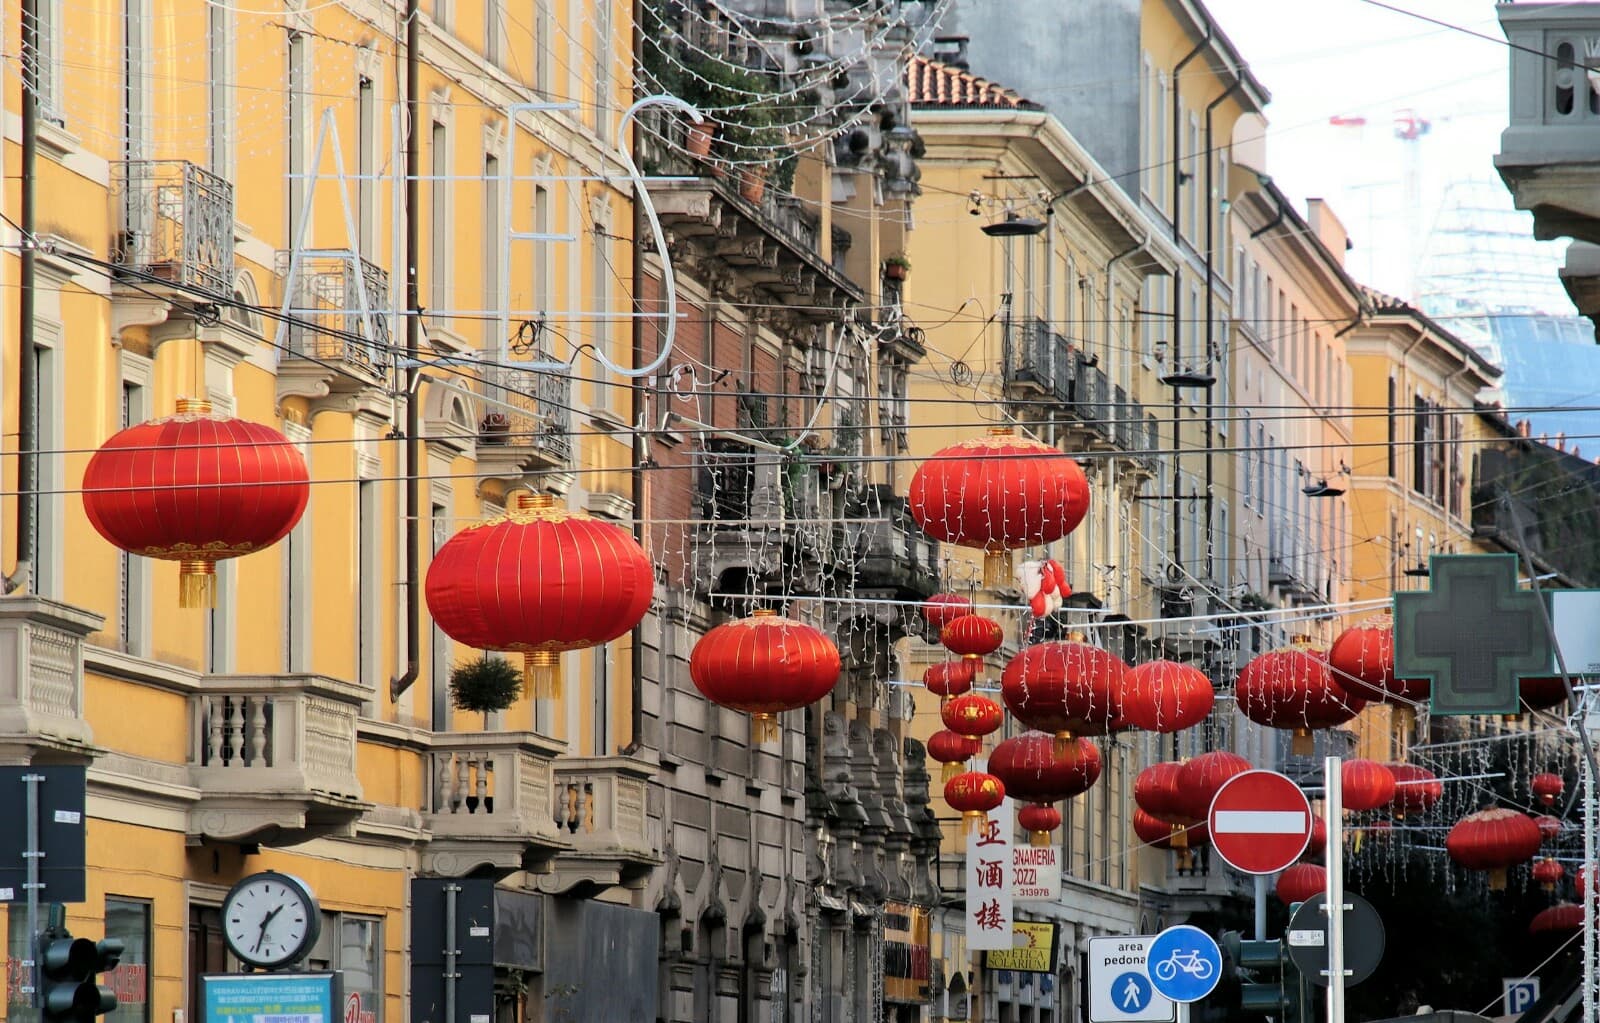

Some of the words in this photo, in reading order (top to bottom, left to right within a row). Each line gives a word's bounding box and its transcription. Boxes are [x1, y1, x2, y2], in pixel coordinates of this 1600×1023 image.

[1118, 943, 1143, 952] area
[992, 948, 1045, 960] ESTETICA
[988, 958, 1047, 970] SOLARIUM
[1515, 987, 1530, 1012] P
